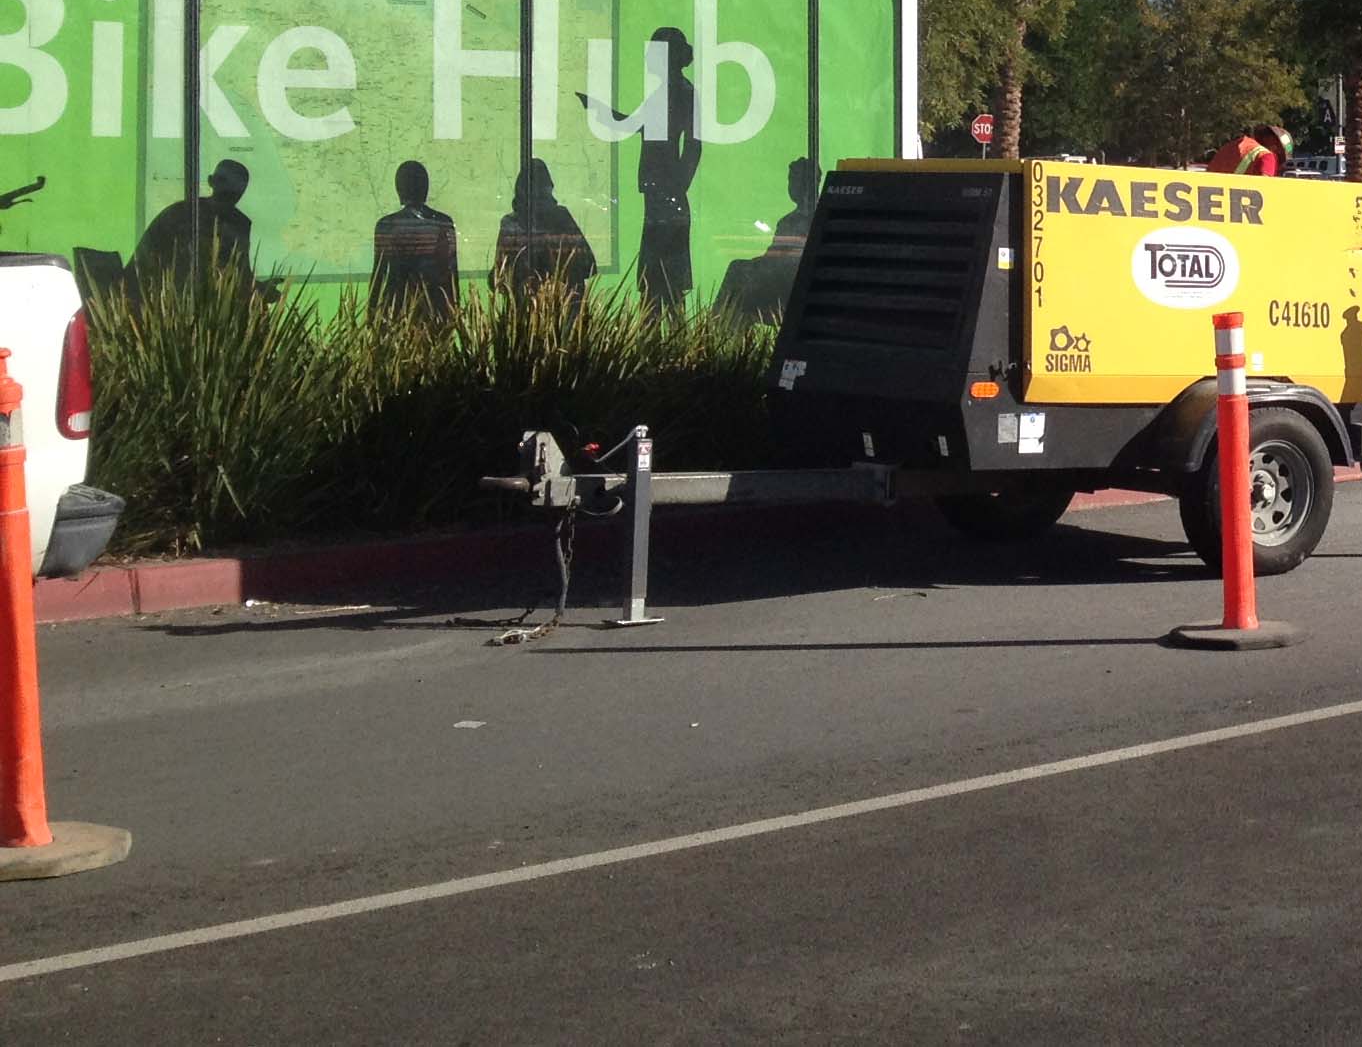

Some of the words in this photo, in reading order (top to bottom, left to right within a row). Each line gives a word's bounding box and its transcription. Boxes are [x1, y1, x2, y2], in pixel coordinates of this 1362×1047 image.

[1046, 175, 1264, 225] KAESER
[1144, 243, 1215, 279] TOTAL
[1269, 299, 1330, 328] C41610
[1045, 353, 1091, 373] SIGMA
